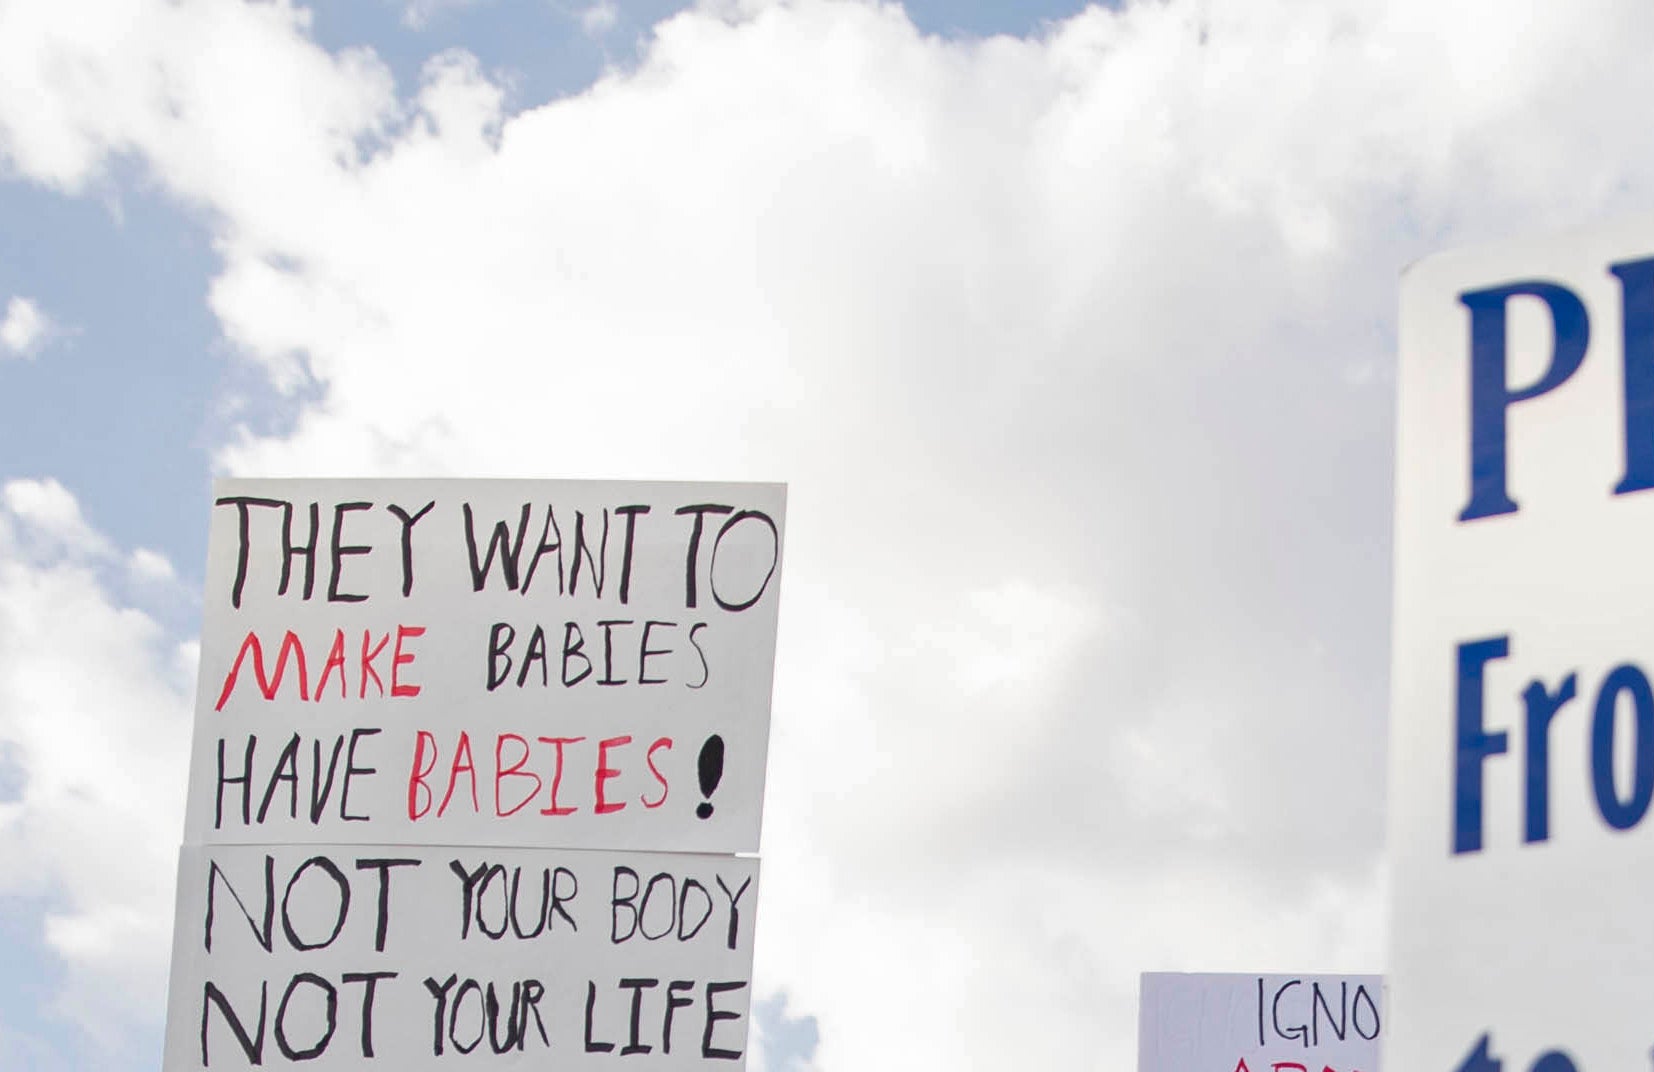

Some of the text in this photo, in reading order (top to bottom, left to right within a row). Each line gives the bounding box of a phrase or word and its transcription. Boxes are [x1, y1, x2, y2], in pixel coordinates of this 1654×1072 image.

[215, 497, 779, 612] THEY WANT TO
[215, 620, 709, 712] MAKE BABIES
[215, 728, 382, 829] HAVE
[205, 855, 751, 953] NOT YOUR BODY
[202, 972, 748, 1067] NOT YOUR LIFE
[1257, 978, 1381, 1048] IGNO
